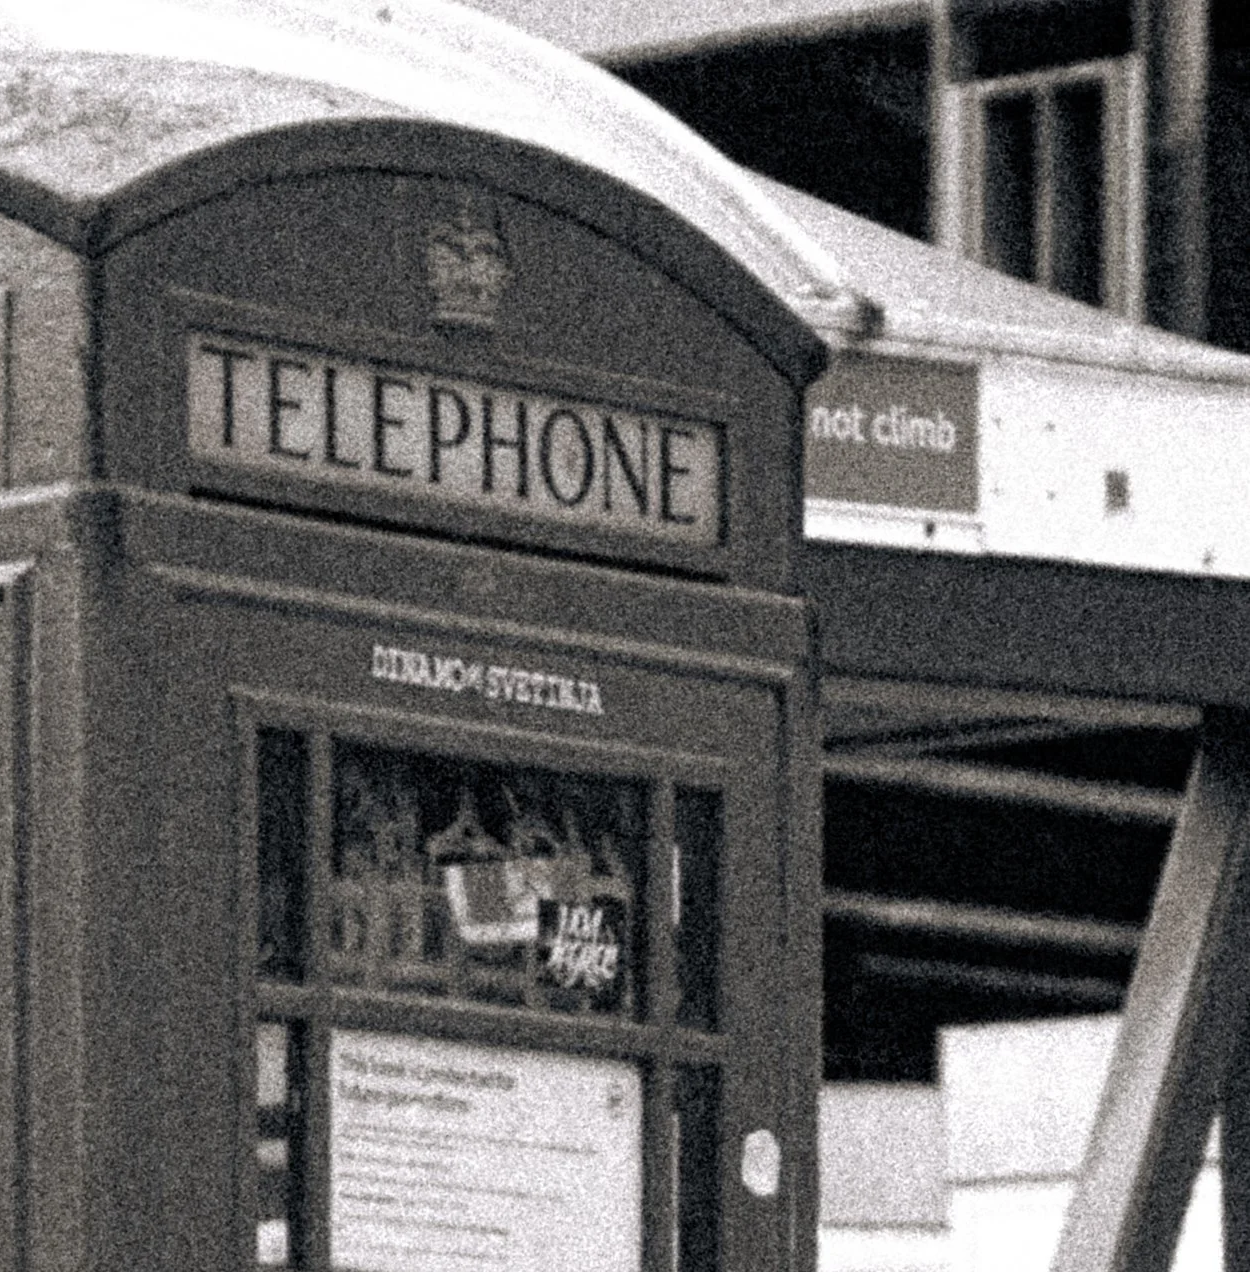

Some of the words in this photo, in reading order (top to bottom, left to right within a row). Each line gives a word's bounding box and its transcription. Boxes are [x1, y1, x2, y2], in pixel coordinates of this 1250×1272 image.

[198, 342, 697, 528] TELEPHONE
[810, 404, 865, 444] not
[871, 403, 957, 453] climb
